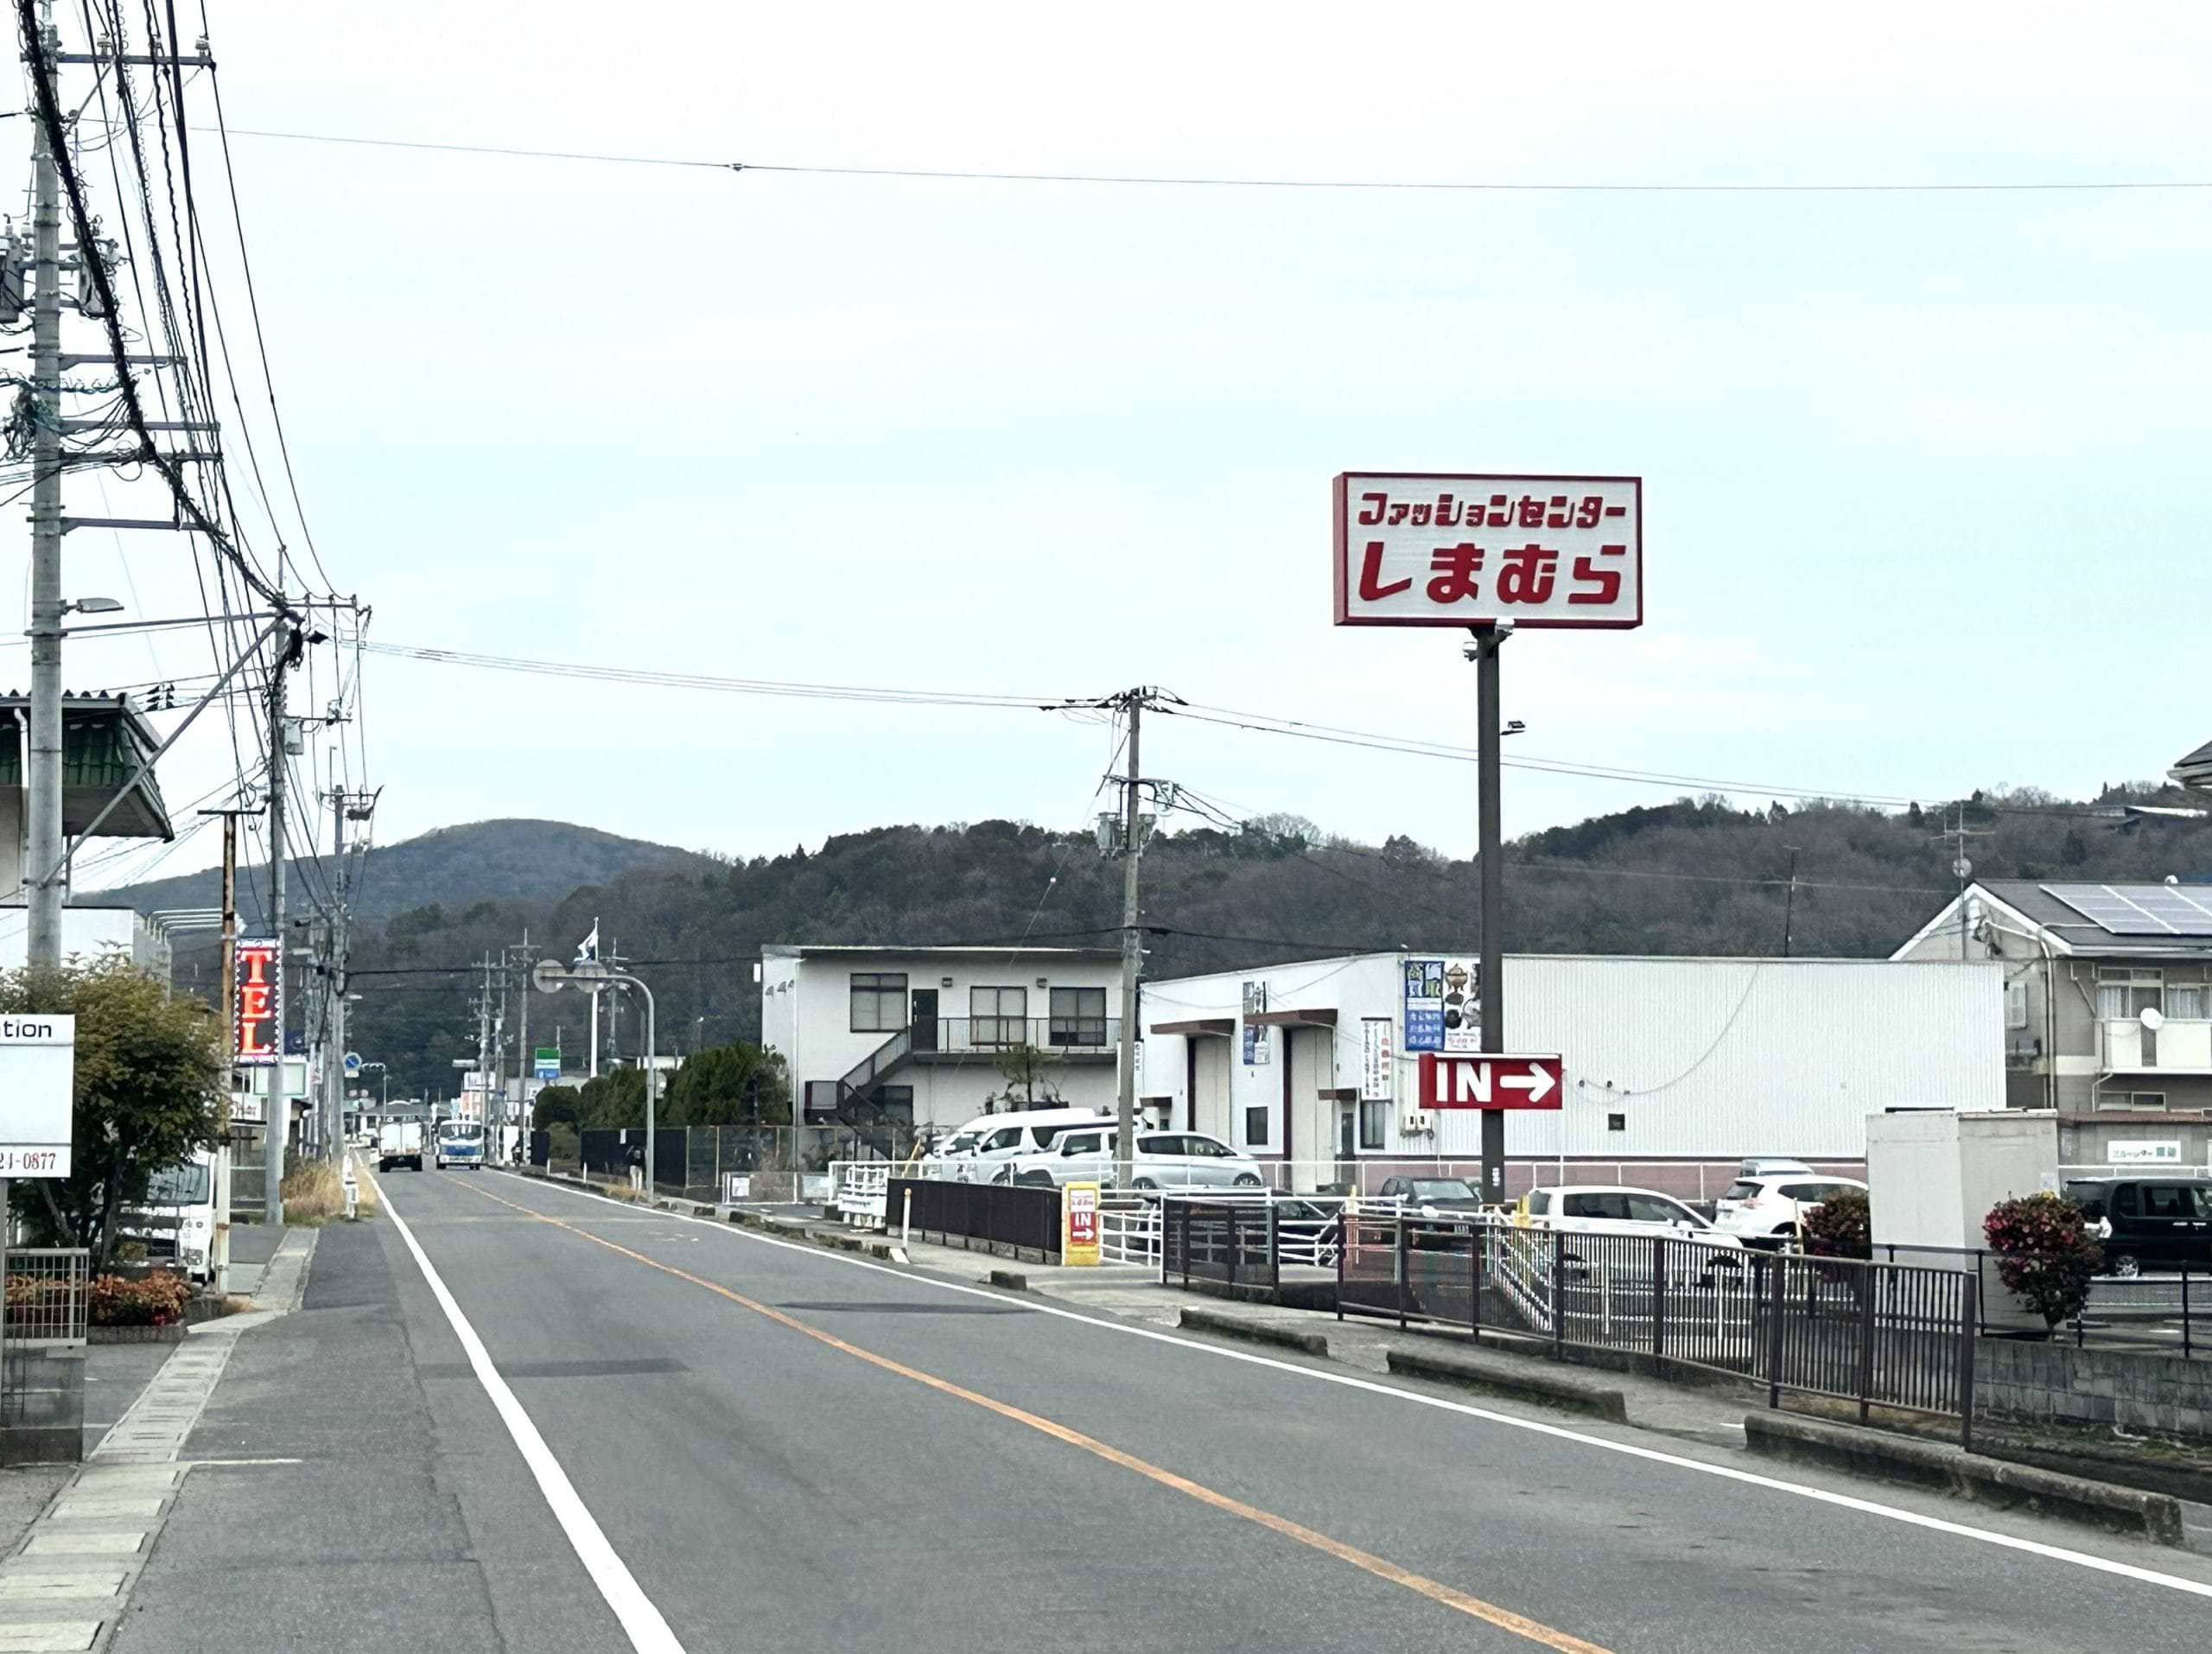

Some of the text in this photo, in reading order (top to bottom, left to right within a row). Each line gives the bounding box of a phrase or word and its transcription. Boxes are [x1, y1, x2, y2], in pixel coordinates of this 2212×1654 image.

[1358, 493, 1626, 528] ファッションセンター
[1358, 541, 1627, 604] しまむら
[241, 950, 273, 1055] TEL
[1435, 1062, 1492, 1103] IN
[1075, 1212, 1092, 1227] IN
